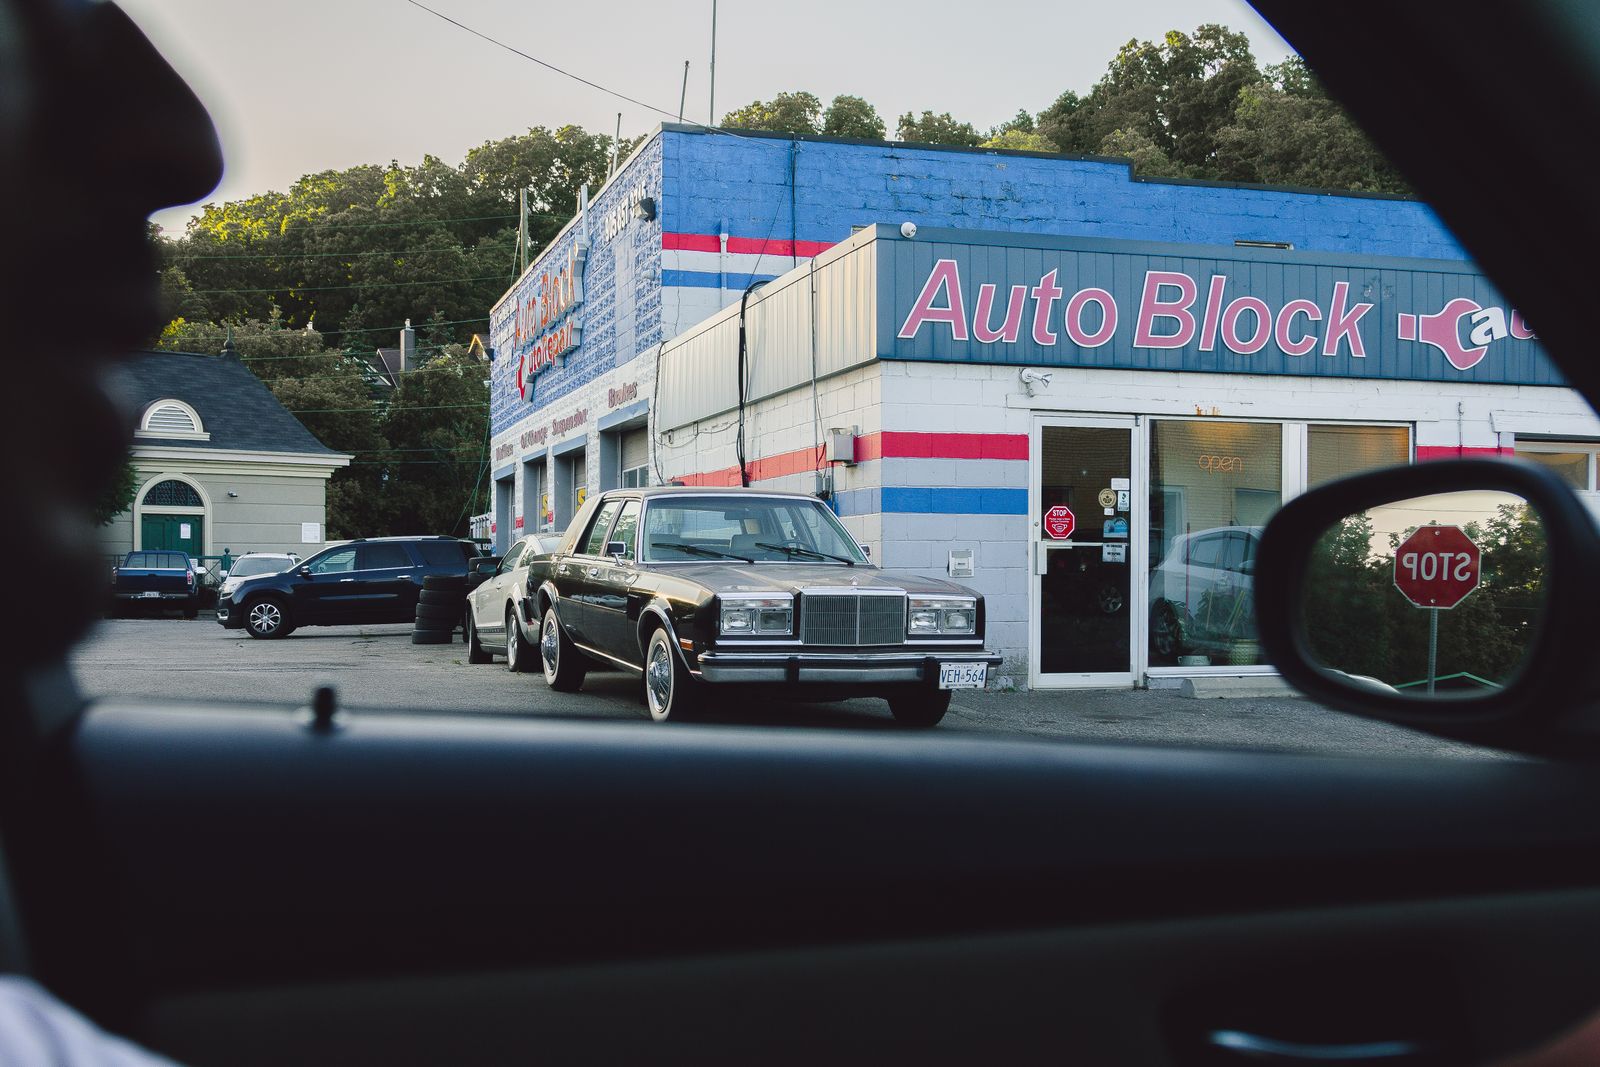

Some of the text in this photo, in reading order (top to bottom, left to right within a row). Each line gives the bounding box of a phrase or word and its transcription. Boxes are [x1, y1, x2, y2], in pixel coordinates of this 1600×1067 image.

[897, 258, 1118, 348] Auto
[1133, 270, 1375, 359] Block
[608, 381, 638, 408] Brakes
[1198, 455, 1242, 475] open
[1052, 509, 1068, 517] STOP
[941, 669, 984, 683] VEH 564
